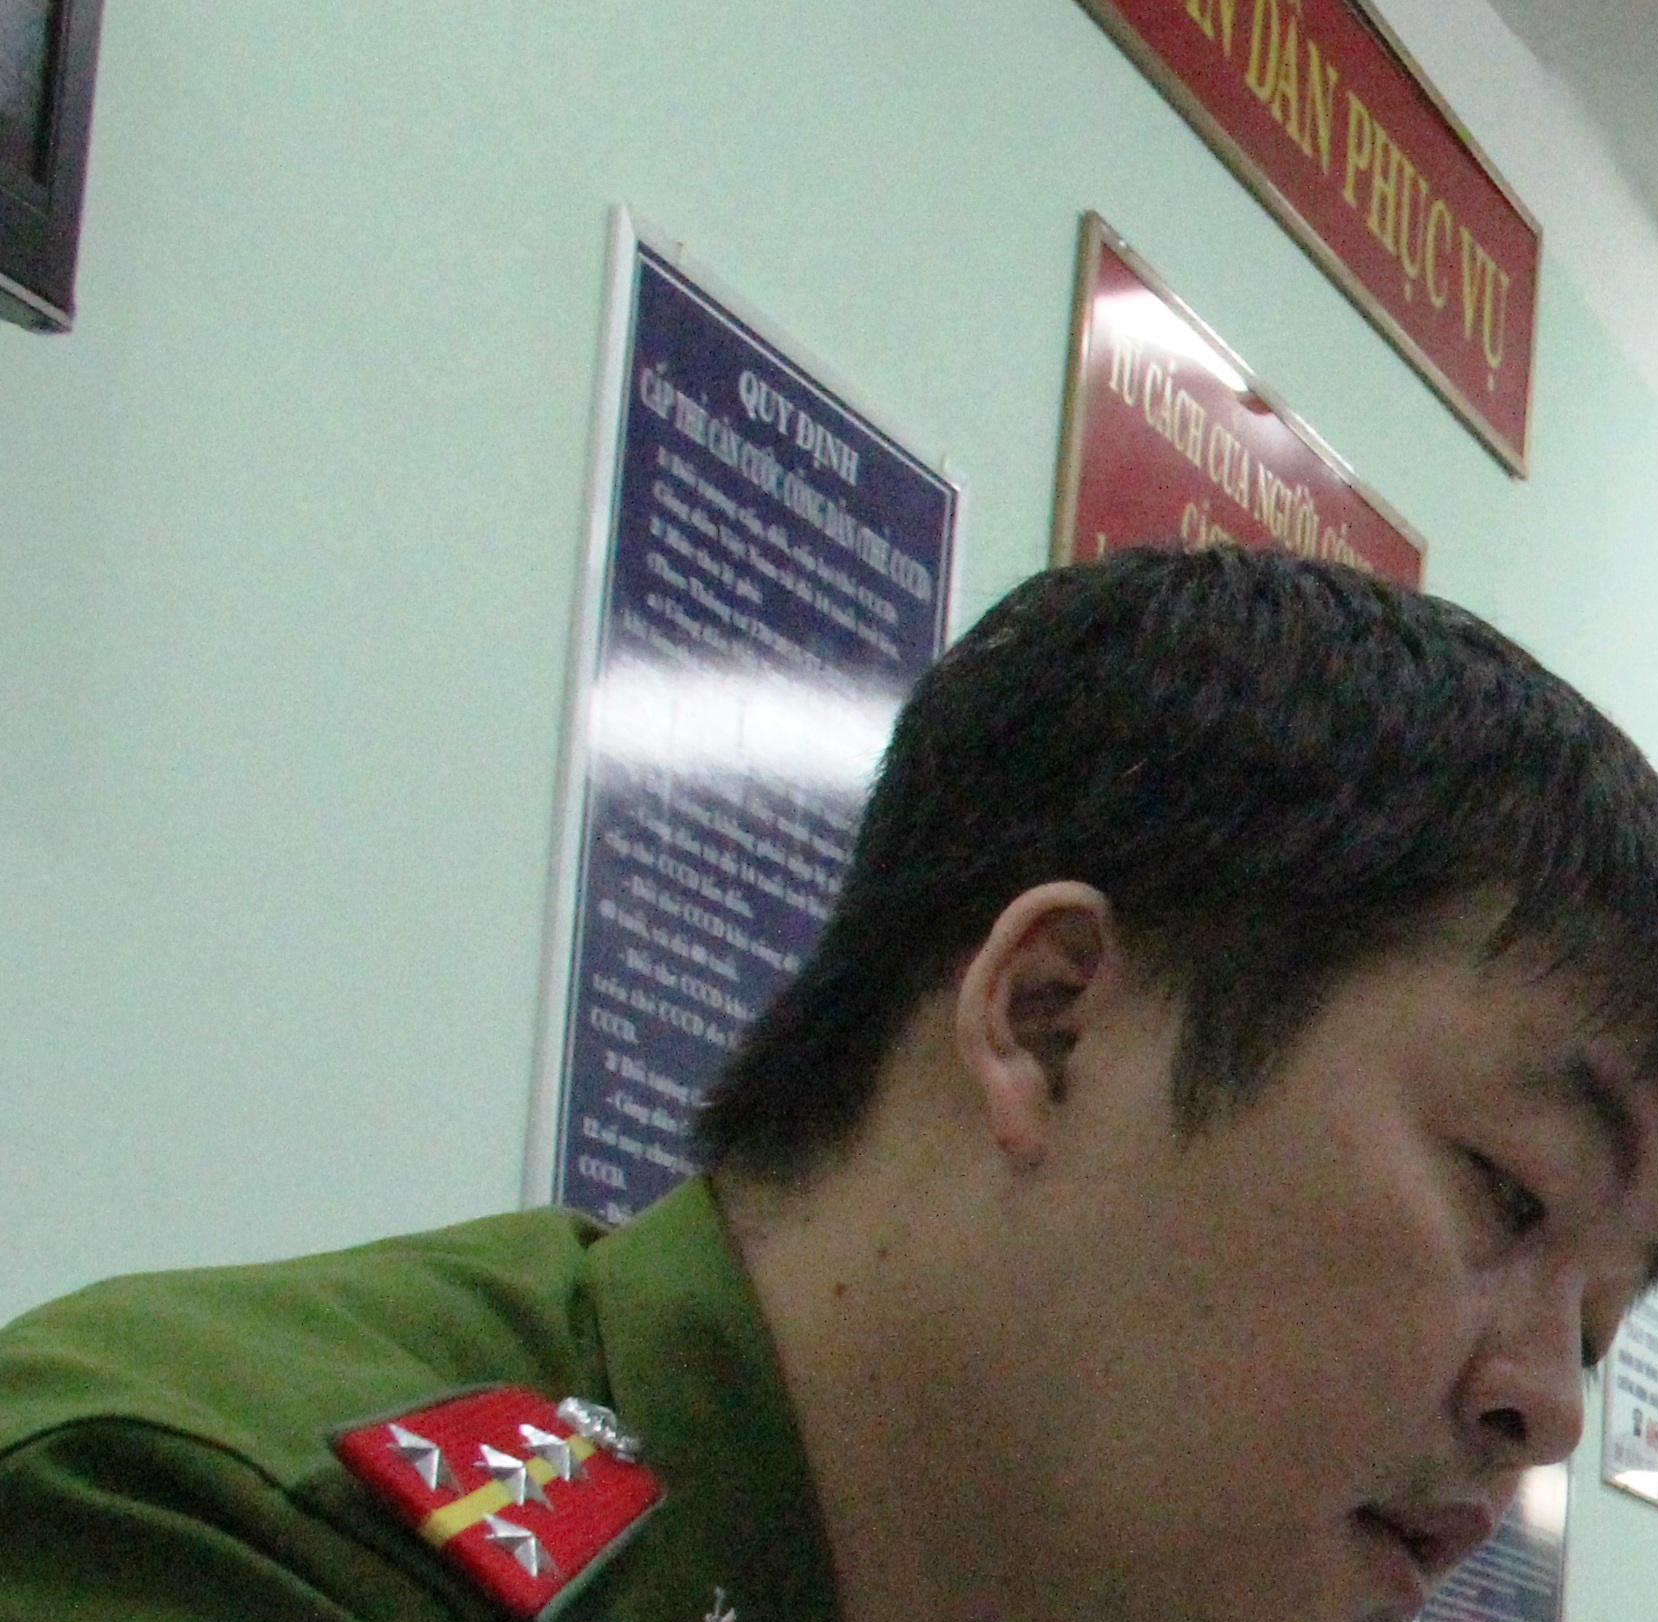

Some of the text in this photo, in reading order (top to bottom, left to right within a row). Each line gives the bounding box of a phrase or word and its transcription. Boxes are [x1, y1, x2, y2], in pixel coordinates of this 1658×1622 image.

[1343, 90, 1451, 308] PHỤC
[1460, 225, 1510, 391] VỤ
[738, 370, 858, 484] QUY ĐỊNH
[1145, 360, 1206, 468] CÁCH
